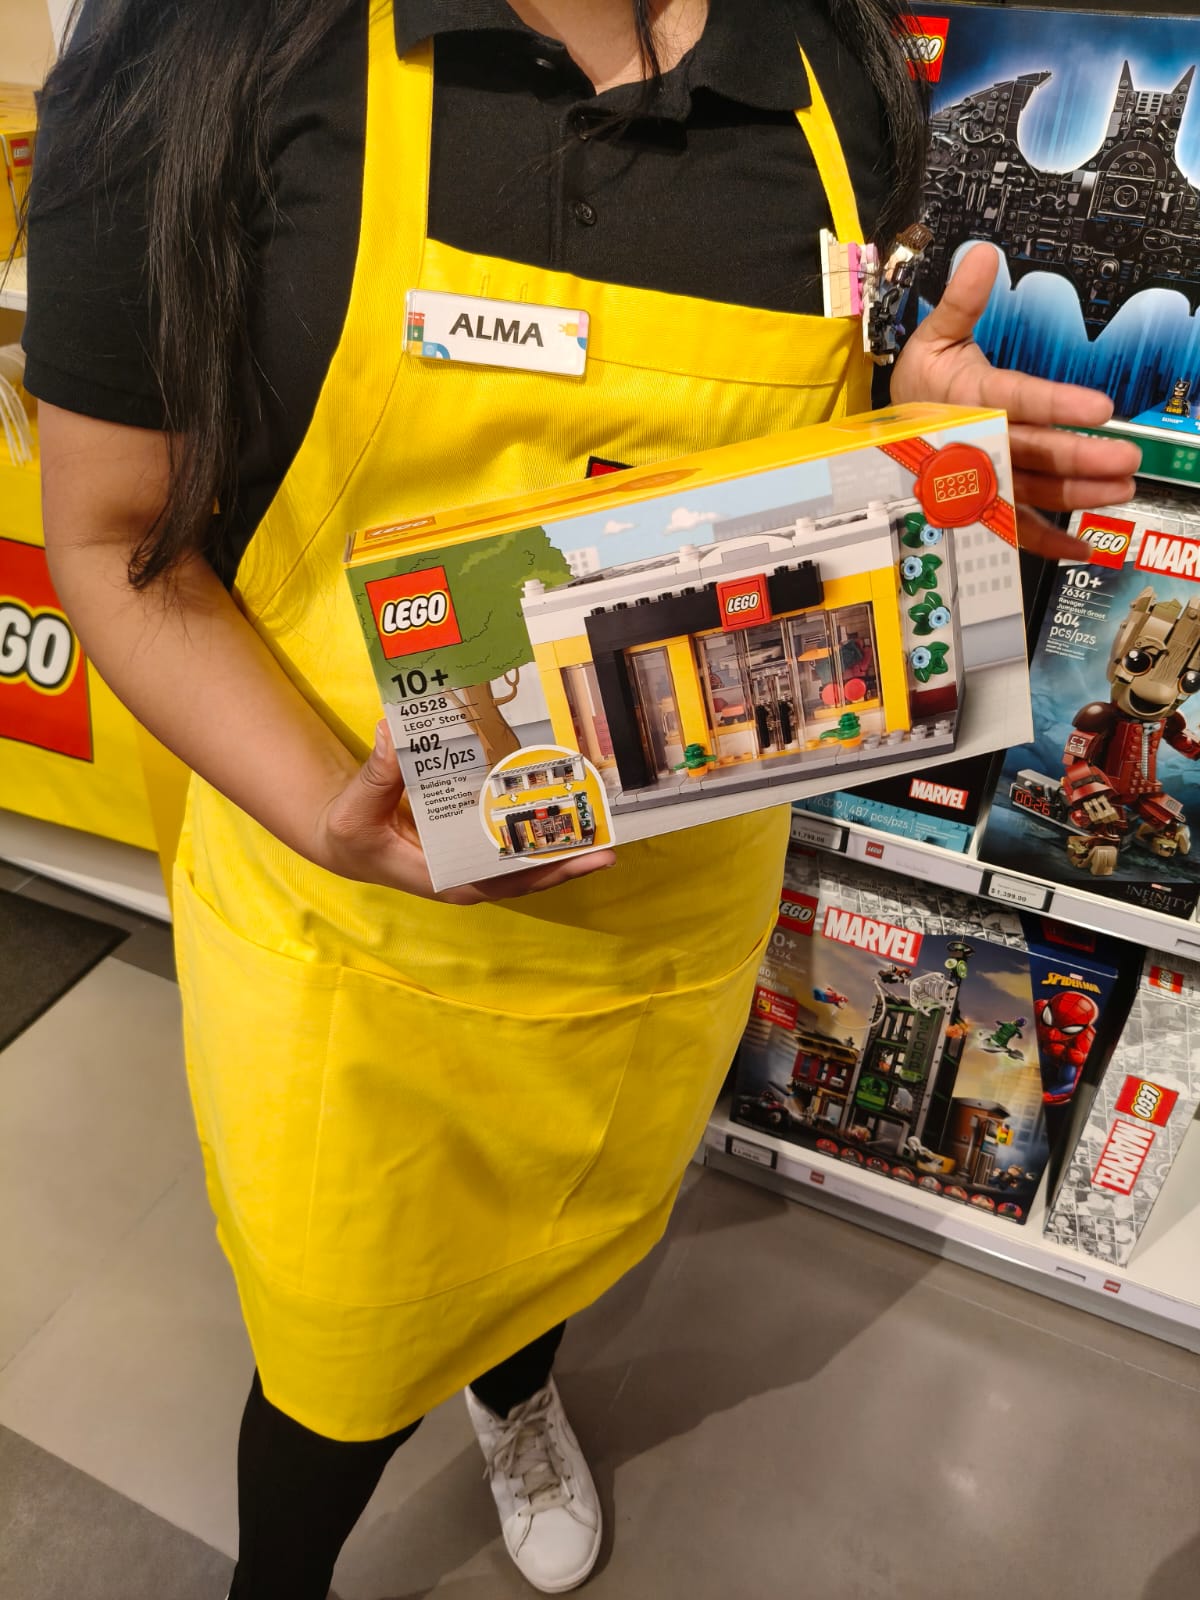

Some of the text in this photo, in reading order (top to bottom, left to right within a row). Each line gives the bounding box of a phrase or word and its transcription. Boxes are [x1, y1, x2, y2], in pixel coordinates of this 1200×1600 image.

[449, 313, 544, 347] ALMA
[1140, 536, 1200, 578] MAR
[1066, 569, 1102, 588] 10+
[727, 593, 758, 613] LEGO
[1058, 597, 1085, 607] Ravager
[1062, 587, 1091, 600] 76341
[383, 592, 447, 632] LEGO
[1054, 612, 1080, 628] 604
[1049, 626, 1097, 645] pcs/pzs
[391, 669, 448, 697] 10+
[400, 697, 447, 716] 40528
[440, 713, 466, 724] Store
[410, 733, 442, 754] 402
[415, 748, 476, 776] pcs/pzs
[420, 778, 452, 790] Building
[423, 790, 444, 799] Jouet
[425, 791, 473, 805] construction
[911, 780, 967, 809] MARVEL
[427, 799, 475, 814] Juguete para
[429, 809, 464, 821] Construir
[1126, 884, 1193, 910] INFINITY
[779, 902, 814, 922] EGO
[773, 932, 798, 949] 0+
[824, 908, 916, 963] MARVEL
[1133, 1083, 1160, 1119] LEGO
[1093, 1120, 1154, 1191] MARVEL
